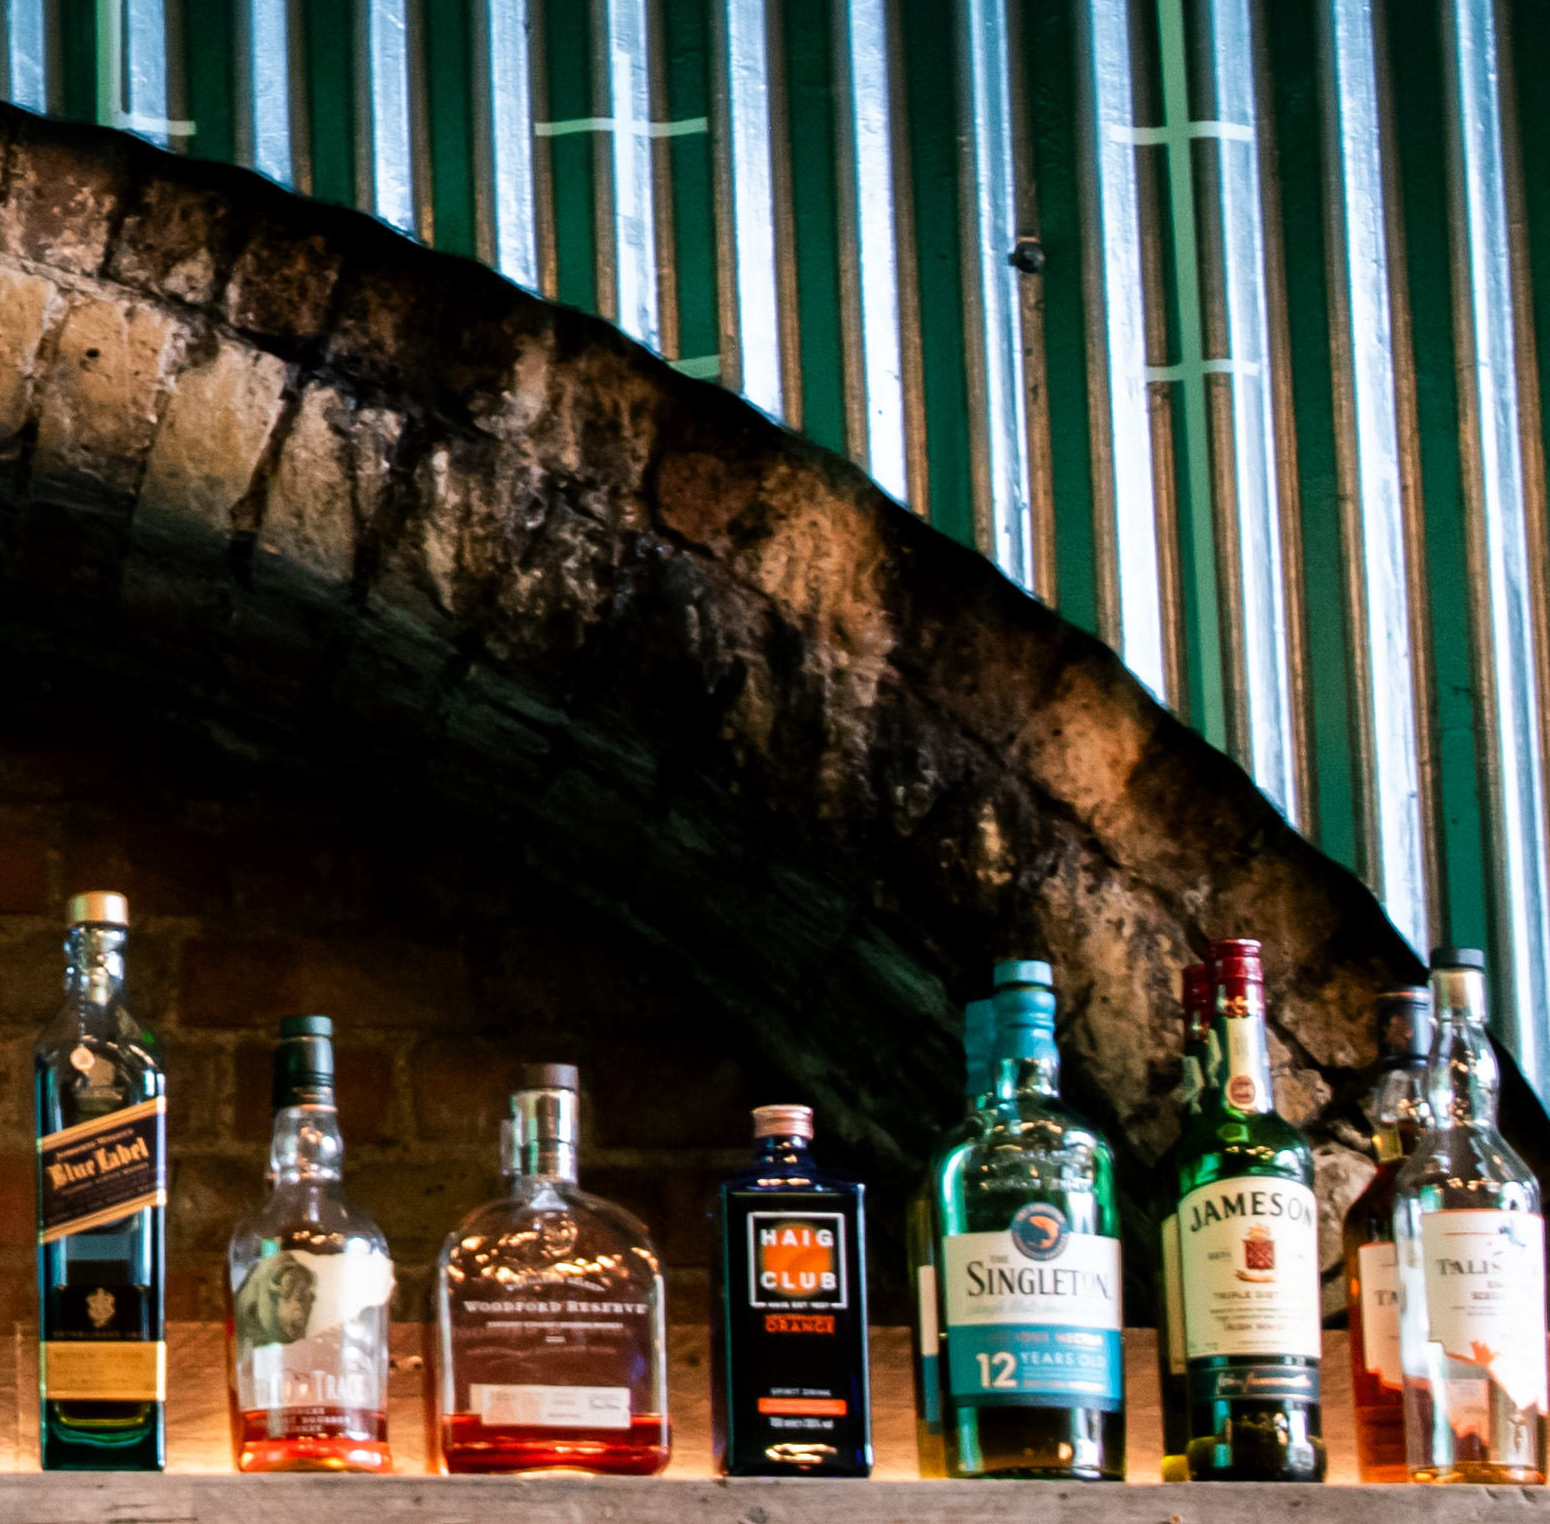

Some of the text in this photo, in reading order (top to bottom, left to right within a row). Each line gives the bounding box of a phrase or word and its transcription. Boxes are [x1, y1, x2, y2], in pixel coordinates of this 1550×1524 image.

[46, 1159, 95, 1190] Blue
[94, 1136, 149, 1173] Label
[1190, 1191, 1312, 1233] JAMESON
[760, 1229, 834, 1247] HAIG
[760, 1271, 837, 1290] CLUB
[463, 1300, 649, 1315] WOODFORD RESERVE
[976, 1351, 1018, 1390] 12
[1020, 1351, 1075, 1366] YEARS
